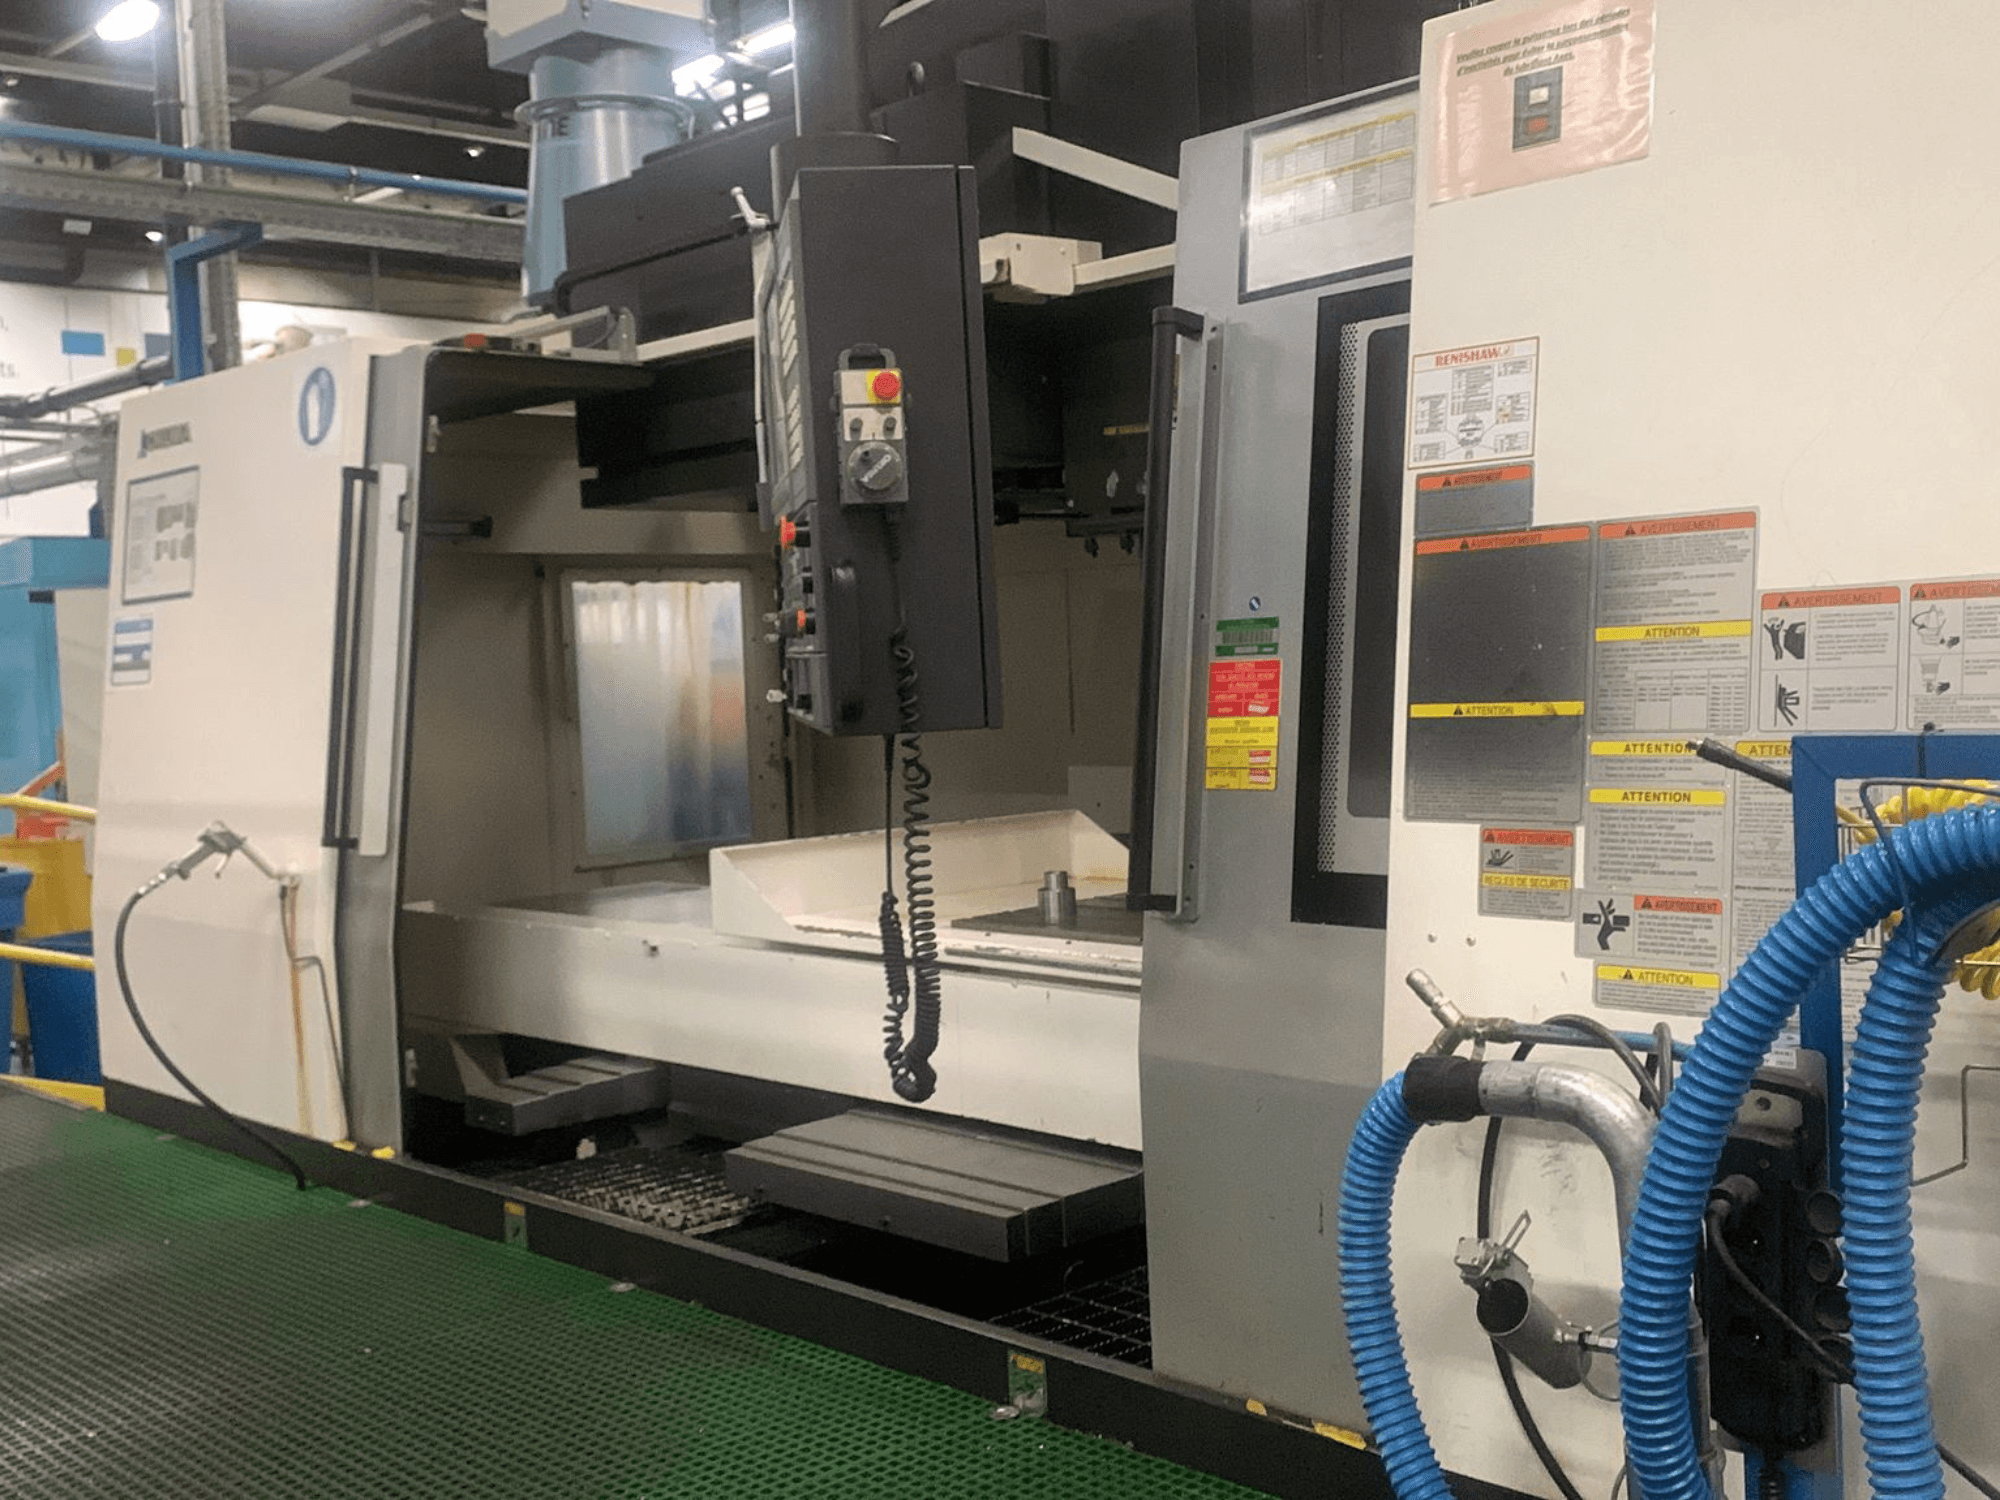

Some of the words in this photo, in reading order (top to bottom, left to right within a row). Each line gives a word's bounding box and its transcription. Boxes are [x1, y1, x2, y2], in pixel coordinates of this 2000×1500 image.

[1435, 347, 1499, 367] RENISHAW
[1794, 592, 1882, 607] AVERTISSEMENT
[1644, 626, 1700, 639] ATTENTION
[1465, 705, 1514, 715] ATTENTION
[1623, 743, 1692, 754] ATTENTION
[1621, 791, 1691, 802] ATTENTION
[1639, 971, 1693, 986] ATTENTION
